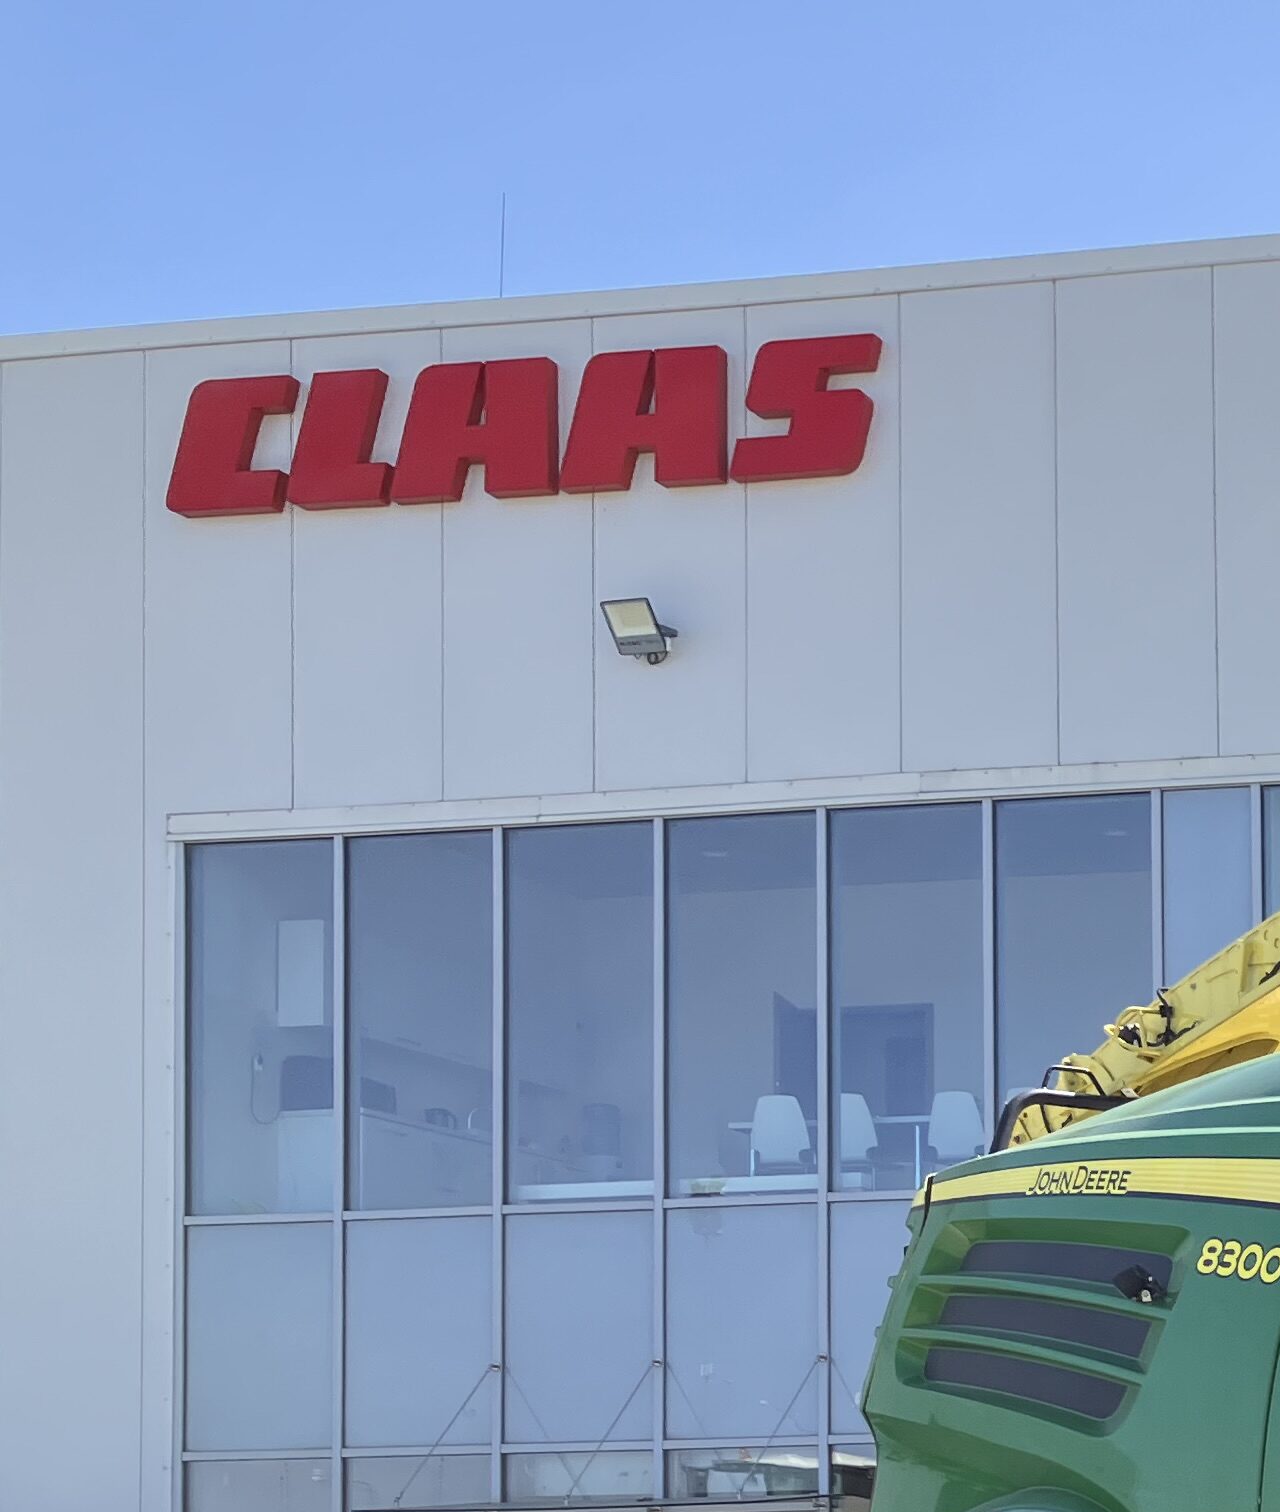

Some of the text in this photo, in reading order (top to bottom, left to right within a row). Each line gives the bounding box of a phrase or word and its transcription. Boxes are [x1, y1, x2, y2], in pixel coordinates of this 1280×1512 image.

[166, 333, 883, 519] CLAAS
[1027, 1165, 1132, 1194] JOHN DEERE
